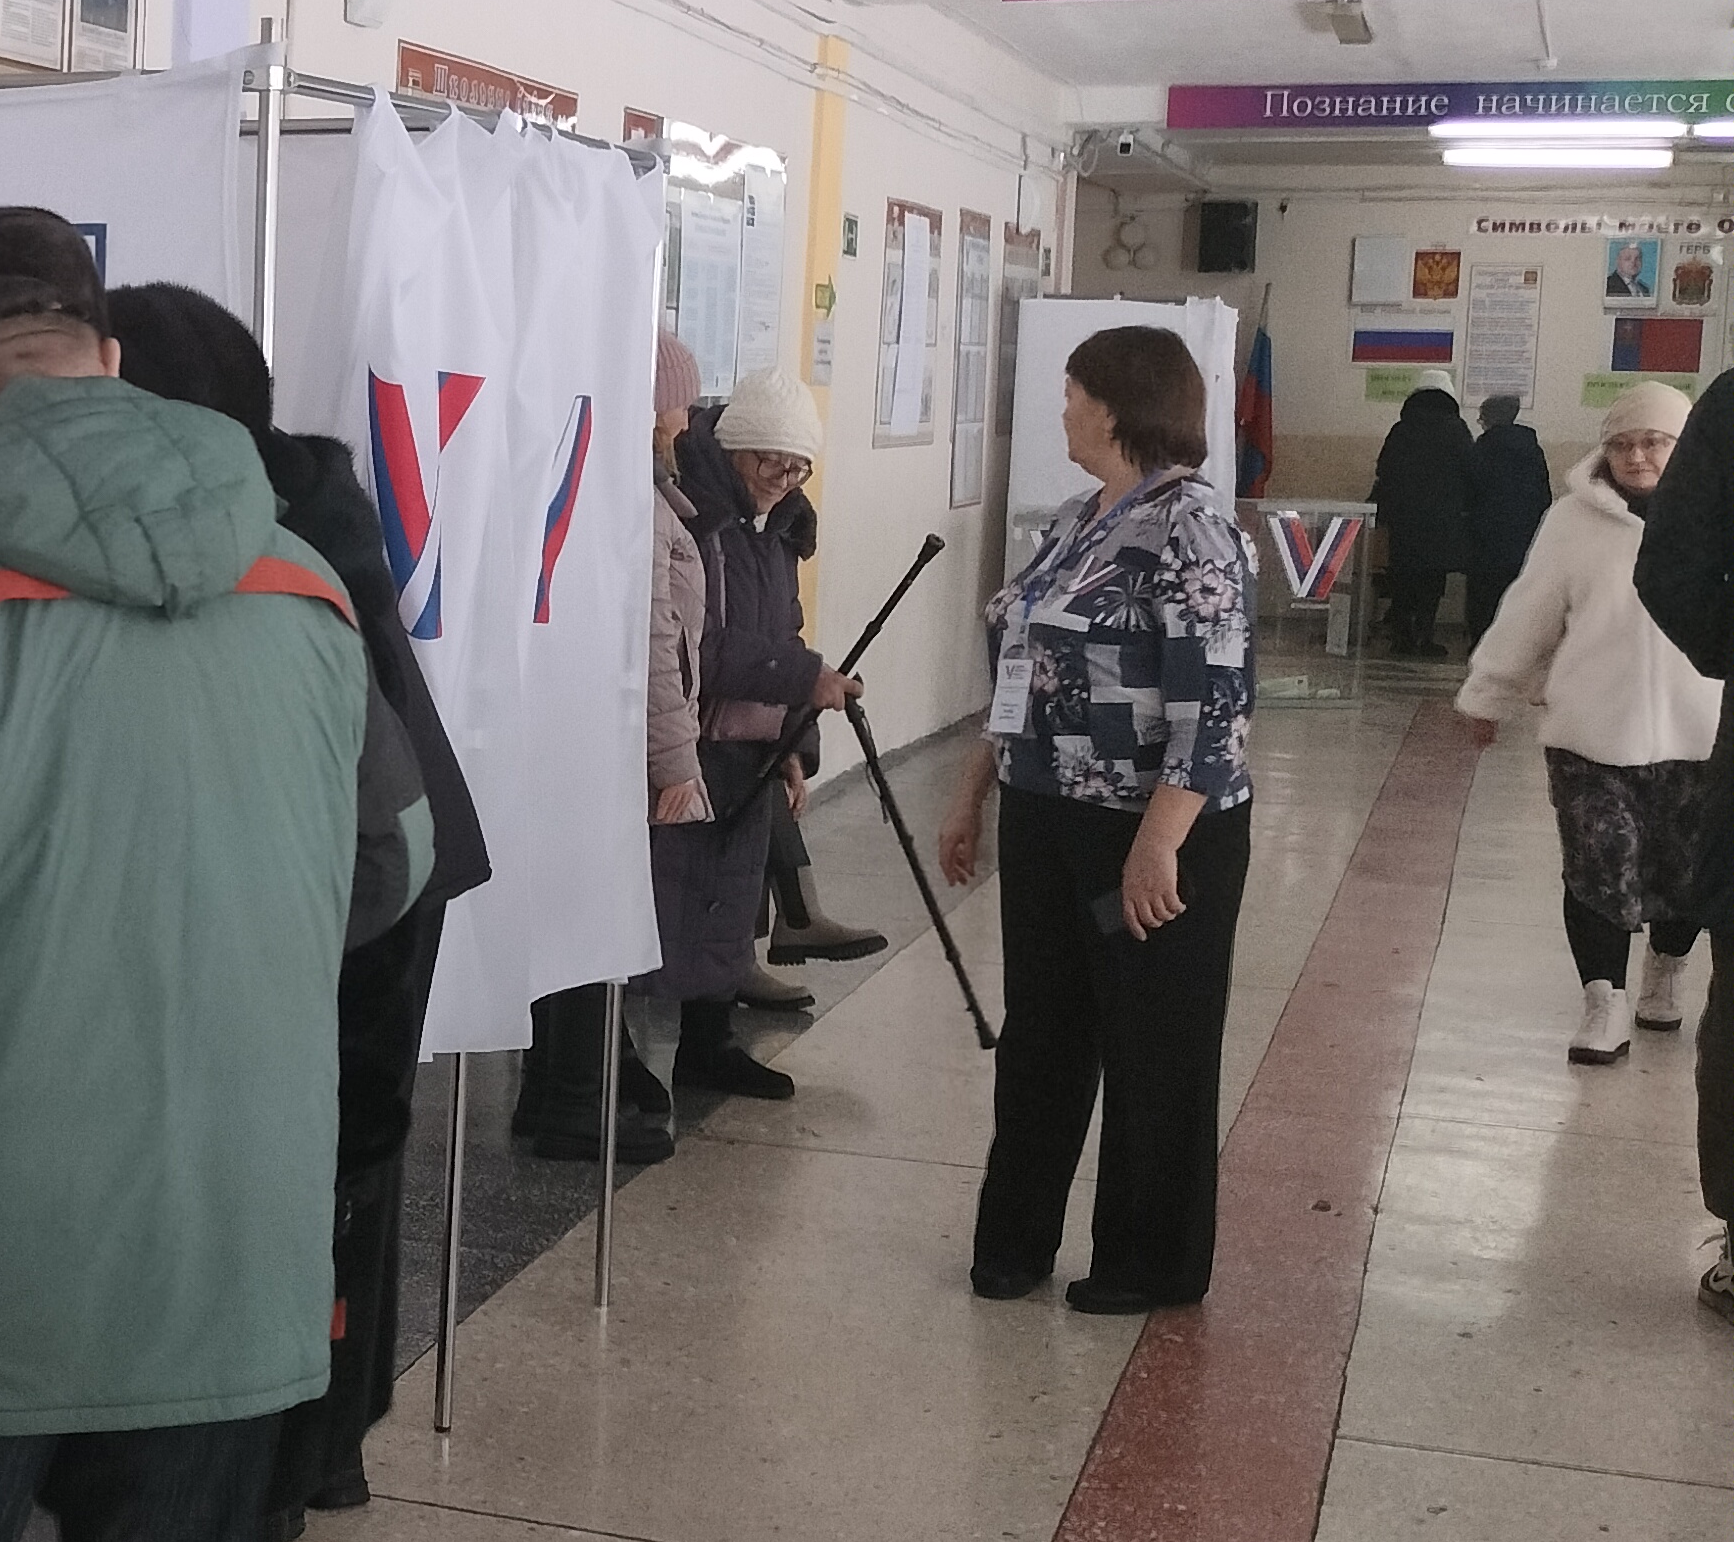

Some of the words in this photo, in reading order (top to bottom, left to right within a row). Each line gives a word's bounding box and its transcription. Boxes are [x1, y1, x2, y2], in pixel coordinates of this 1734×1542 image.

[1262, 89, 1450, 118] Познание
[1475, 92, 1711, 116] начинается
[1476, 216, 1602, 234] Символы
[1679, 243, 1711, 255] ГЕРБ
